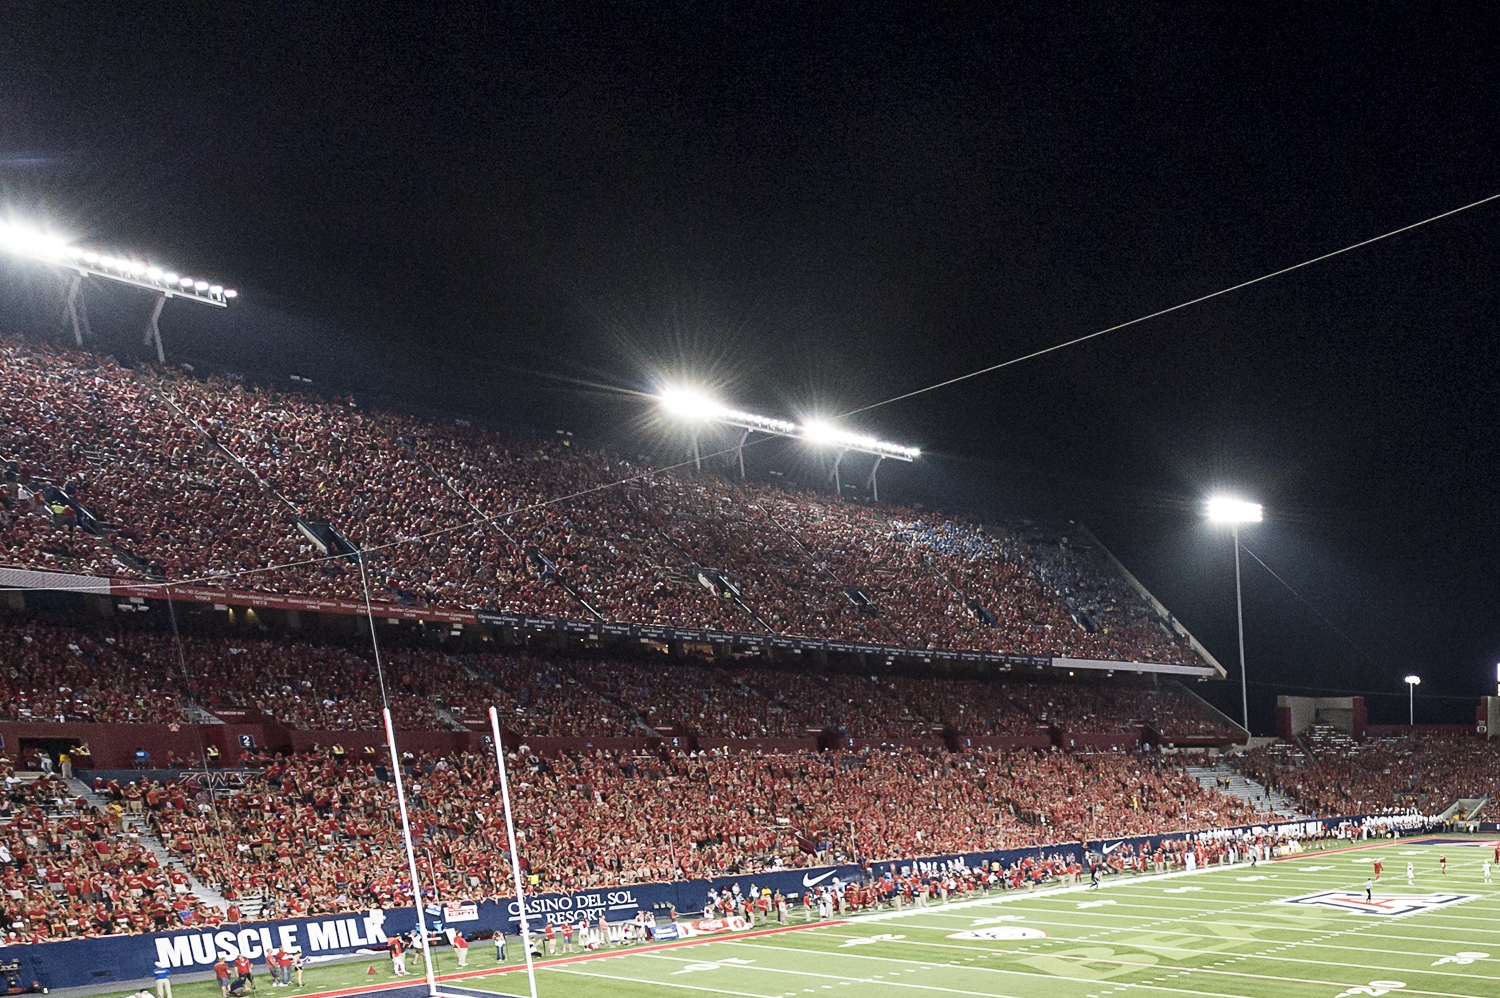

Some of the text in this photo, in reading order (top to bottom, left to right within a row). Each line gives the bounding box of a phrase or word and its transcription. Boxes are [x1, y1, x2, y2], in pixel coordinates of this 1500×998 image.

[194, 590, 227, 598] Conference
[242, 735, 250, 744] 2
[508, 890, 638, 916] CASINO DEL SOL
[546, 907, 607, 926] RESORT
[154, 916, 389, 968] MUSCLE MILK
[1345, 980, 1408, 998] 20
